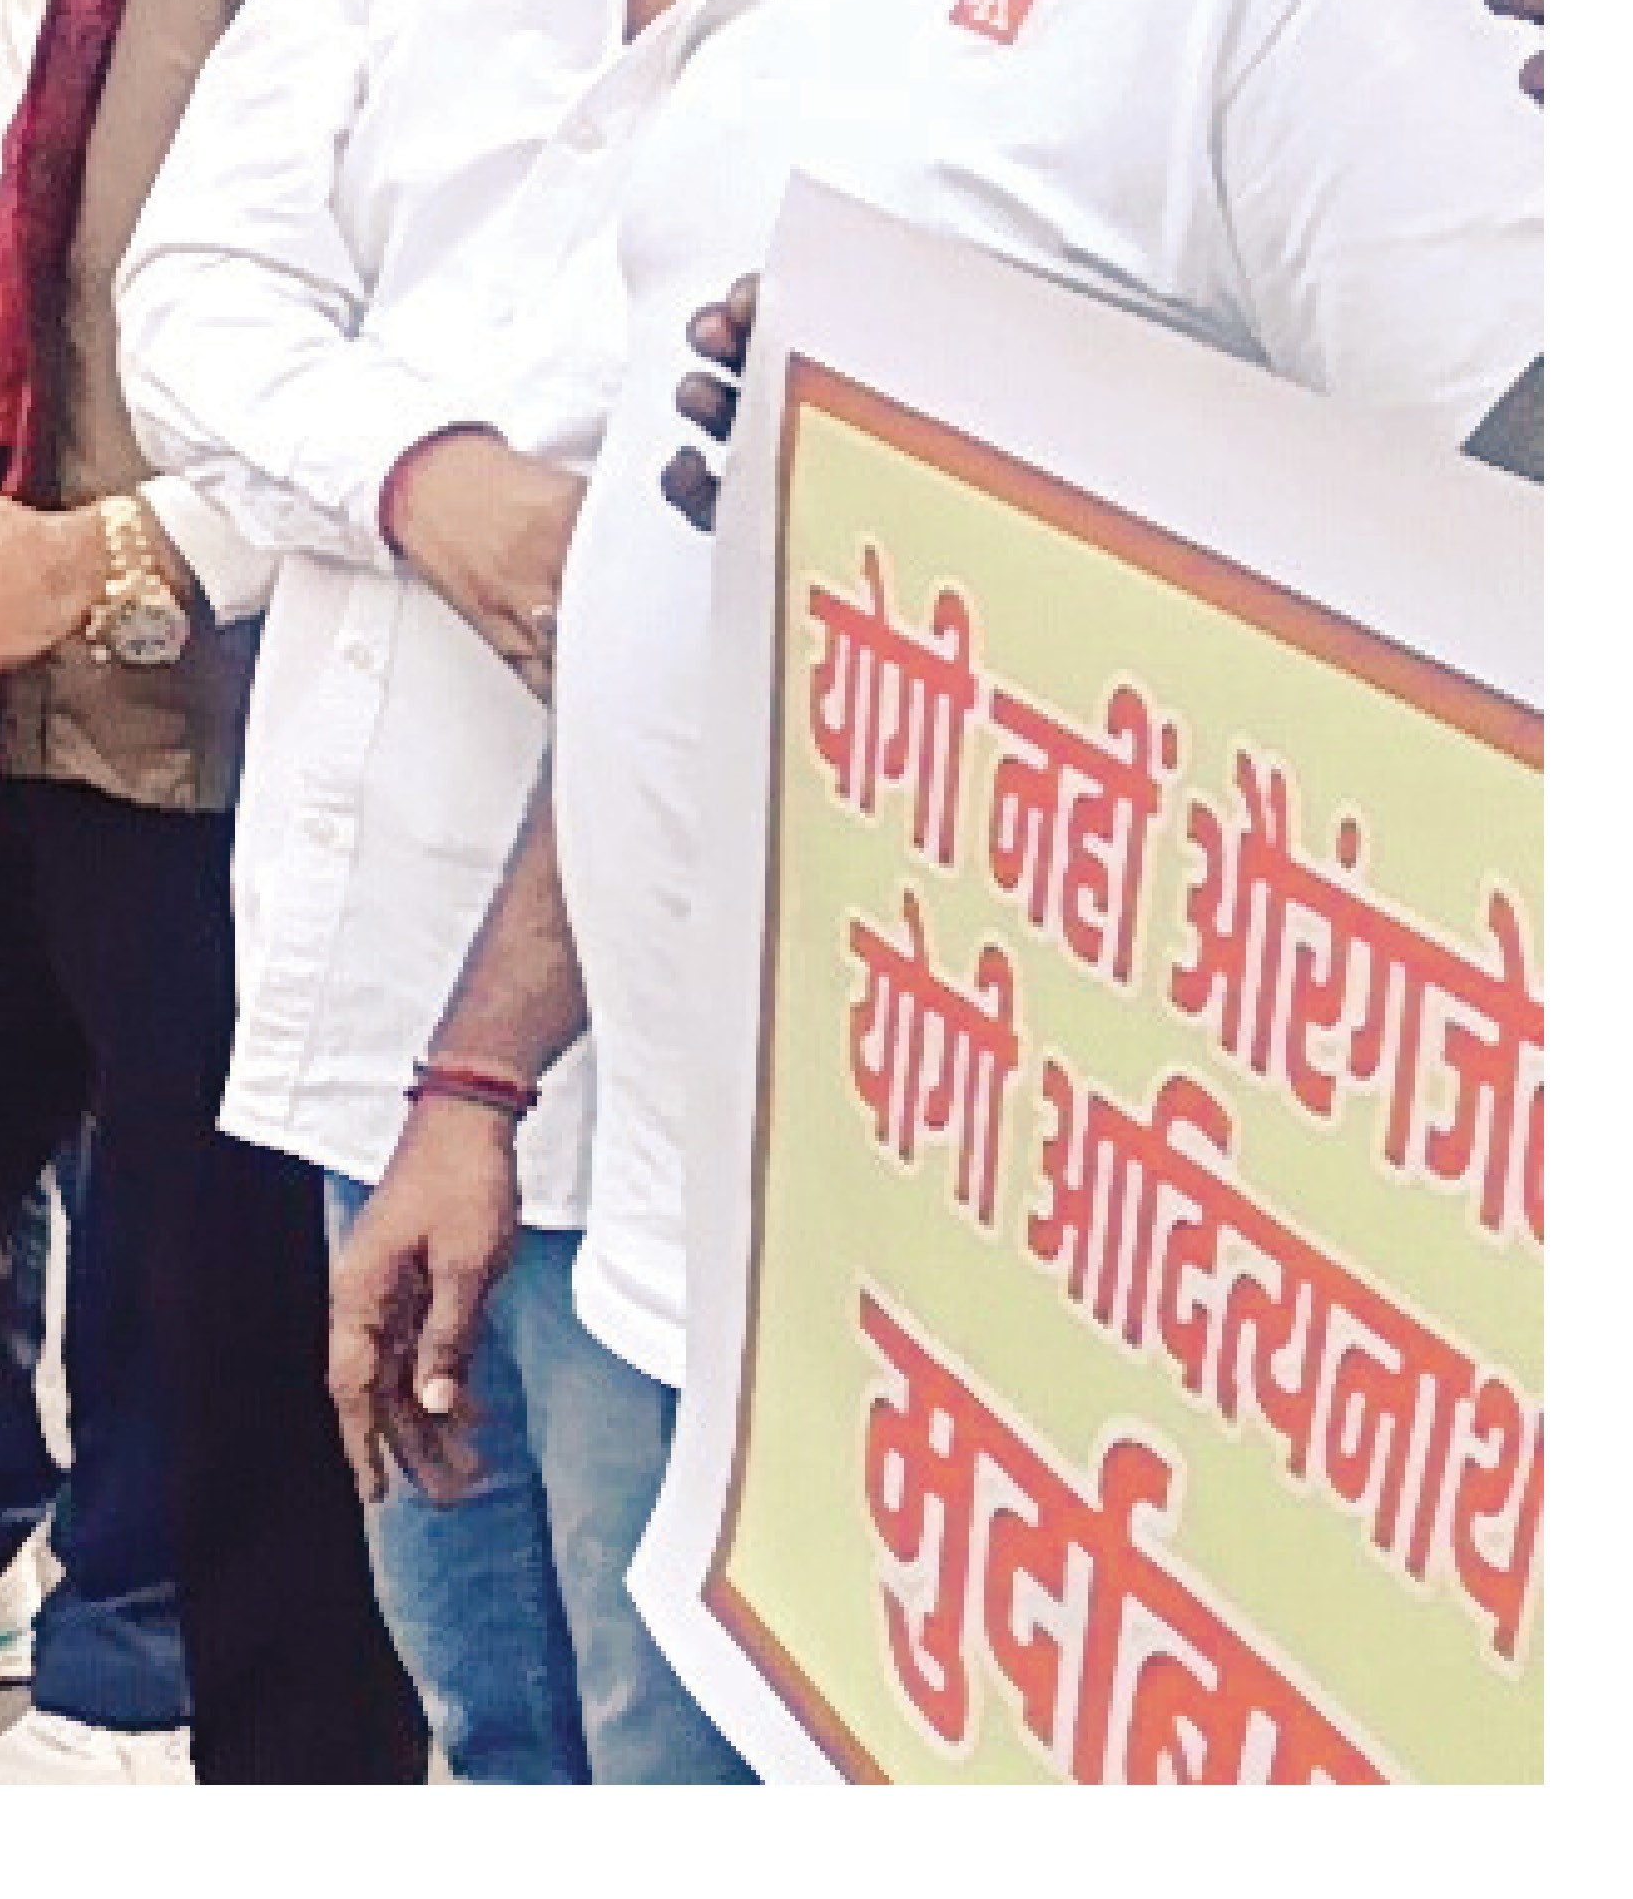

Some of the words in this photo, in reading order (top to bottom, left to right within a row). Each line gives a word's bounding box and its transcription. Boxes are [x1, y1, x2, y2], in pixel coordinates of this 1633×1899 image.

[810, 545, 979, 865] योगी
[990, 683, 1178, 983] नहीं
[1170, 748, 1545, 1245] औरंगजे
[849, 891, 1020, 1227] योगी
[1027, 1059, 1545, 1661] आदित्यनाथ
